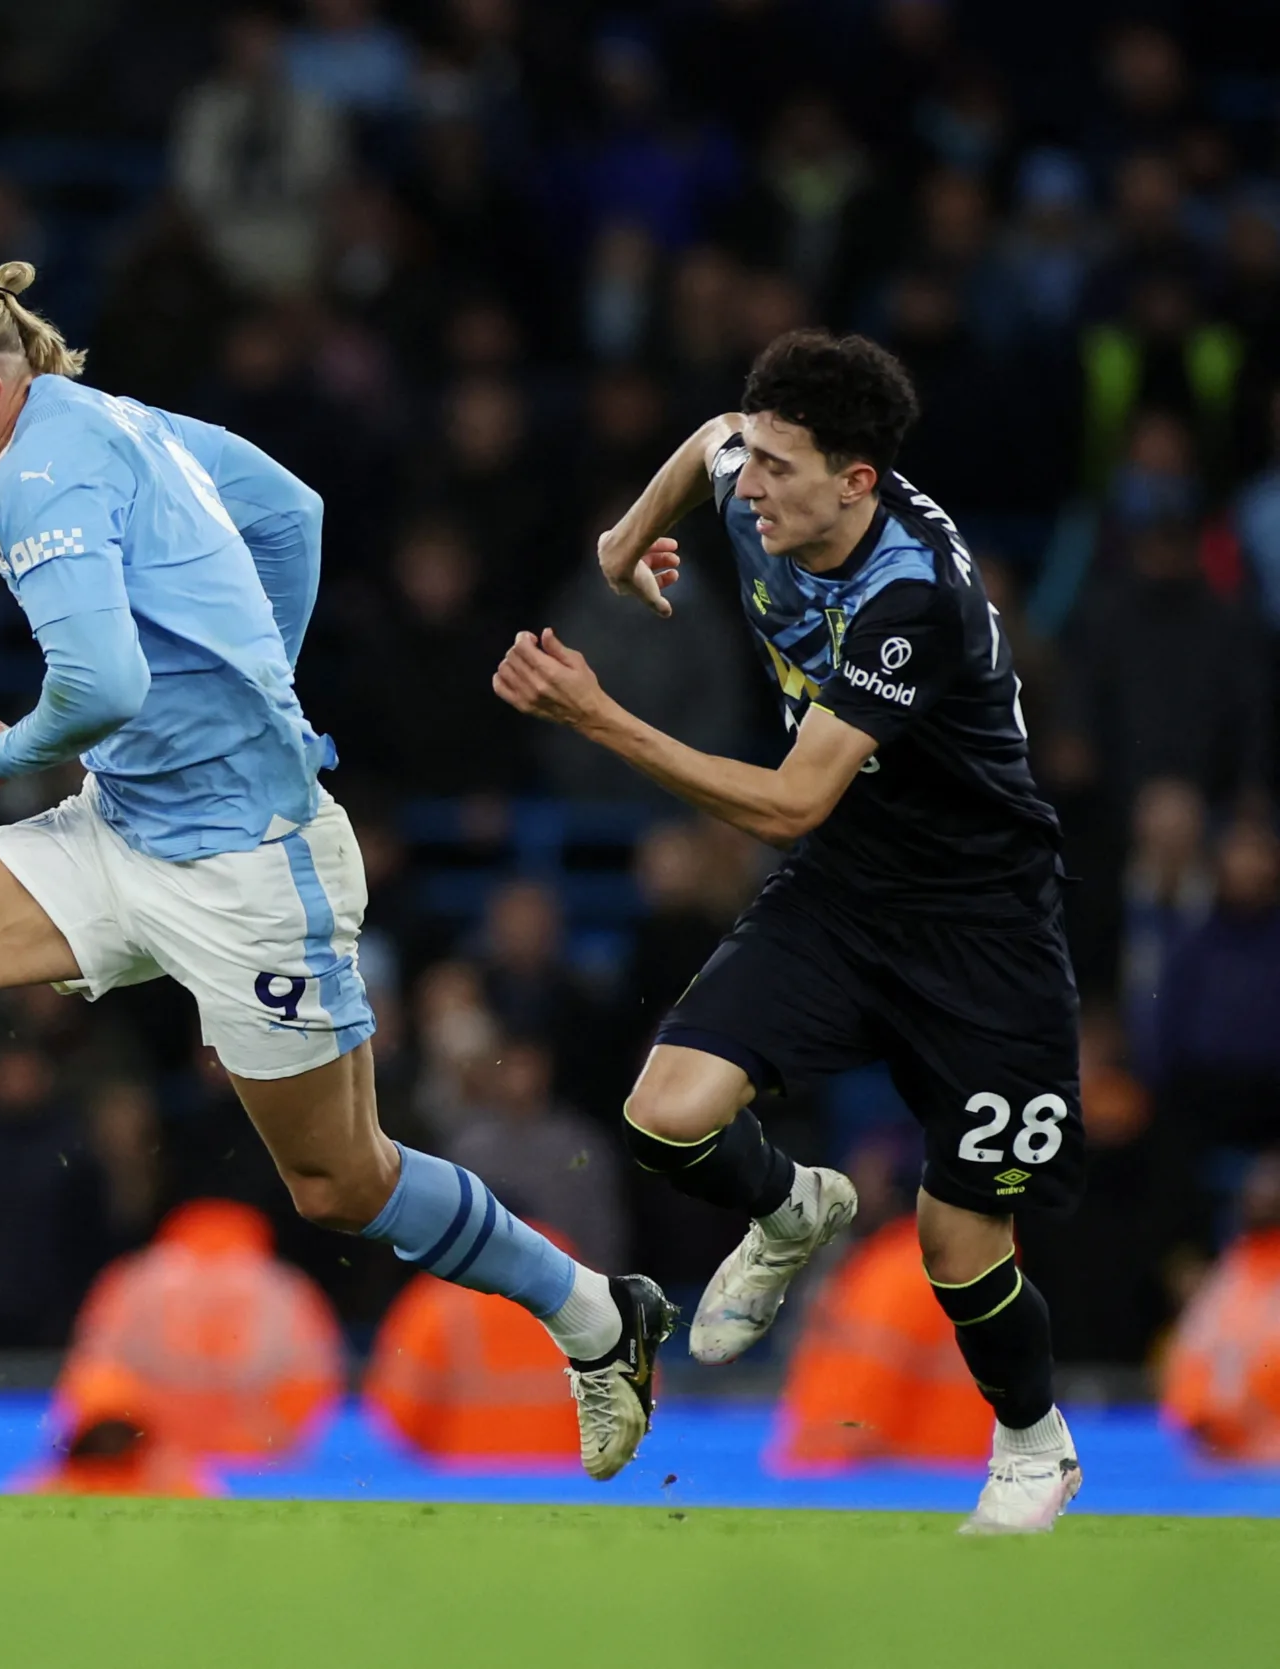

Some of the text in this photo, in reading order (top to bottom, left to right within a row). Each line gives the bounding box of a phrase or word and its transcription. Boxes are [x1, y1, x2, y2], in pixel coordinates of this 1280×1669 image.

[842, 660, 917, 706] uphold
[254, 971, 307, 1022] 9
[958, 1091, 1068, 1164] 28
